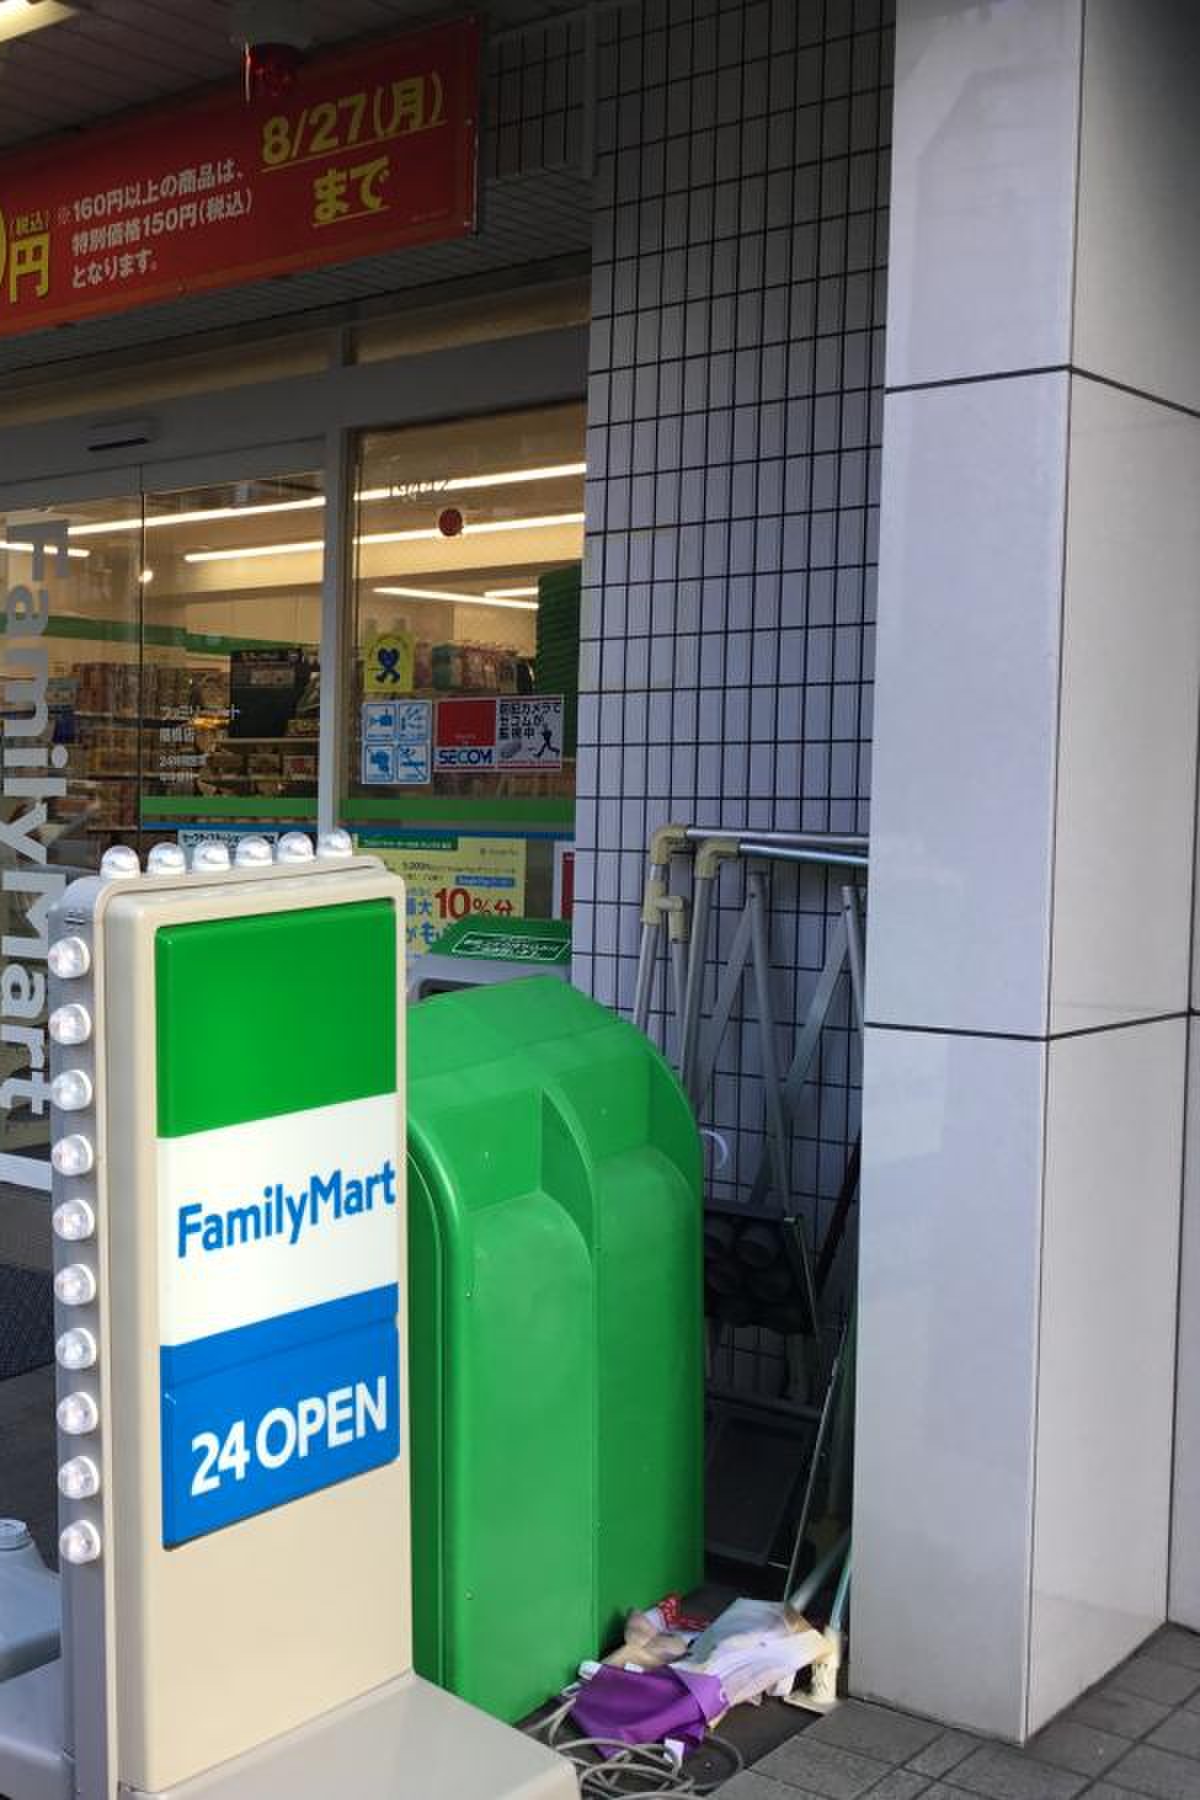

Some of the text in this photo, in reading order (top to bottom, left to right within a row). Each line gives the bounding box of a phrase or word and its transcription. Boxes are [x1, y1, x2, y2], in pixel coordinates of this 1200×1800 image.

[262, 70, 443, 166] 8/27(月)
[313, 156, 391, 225] まで
[71, 249, 158, 290] となります。
[439, 750, 492, 765] SECOM
[178, 1159, 396, 1258] FamilyMart
[191, 1376, 387, 1496] 24 OPEN
